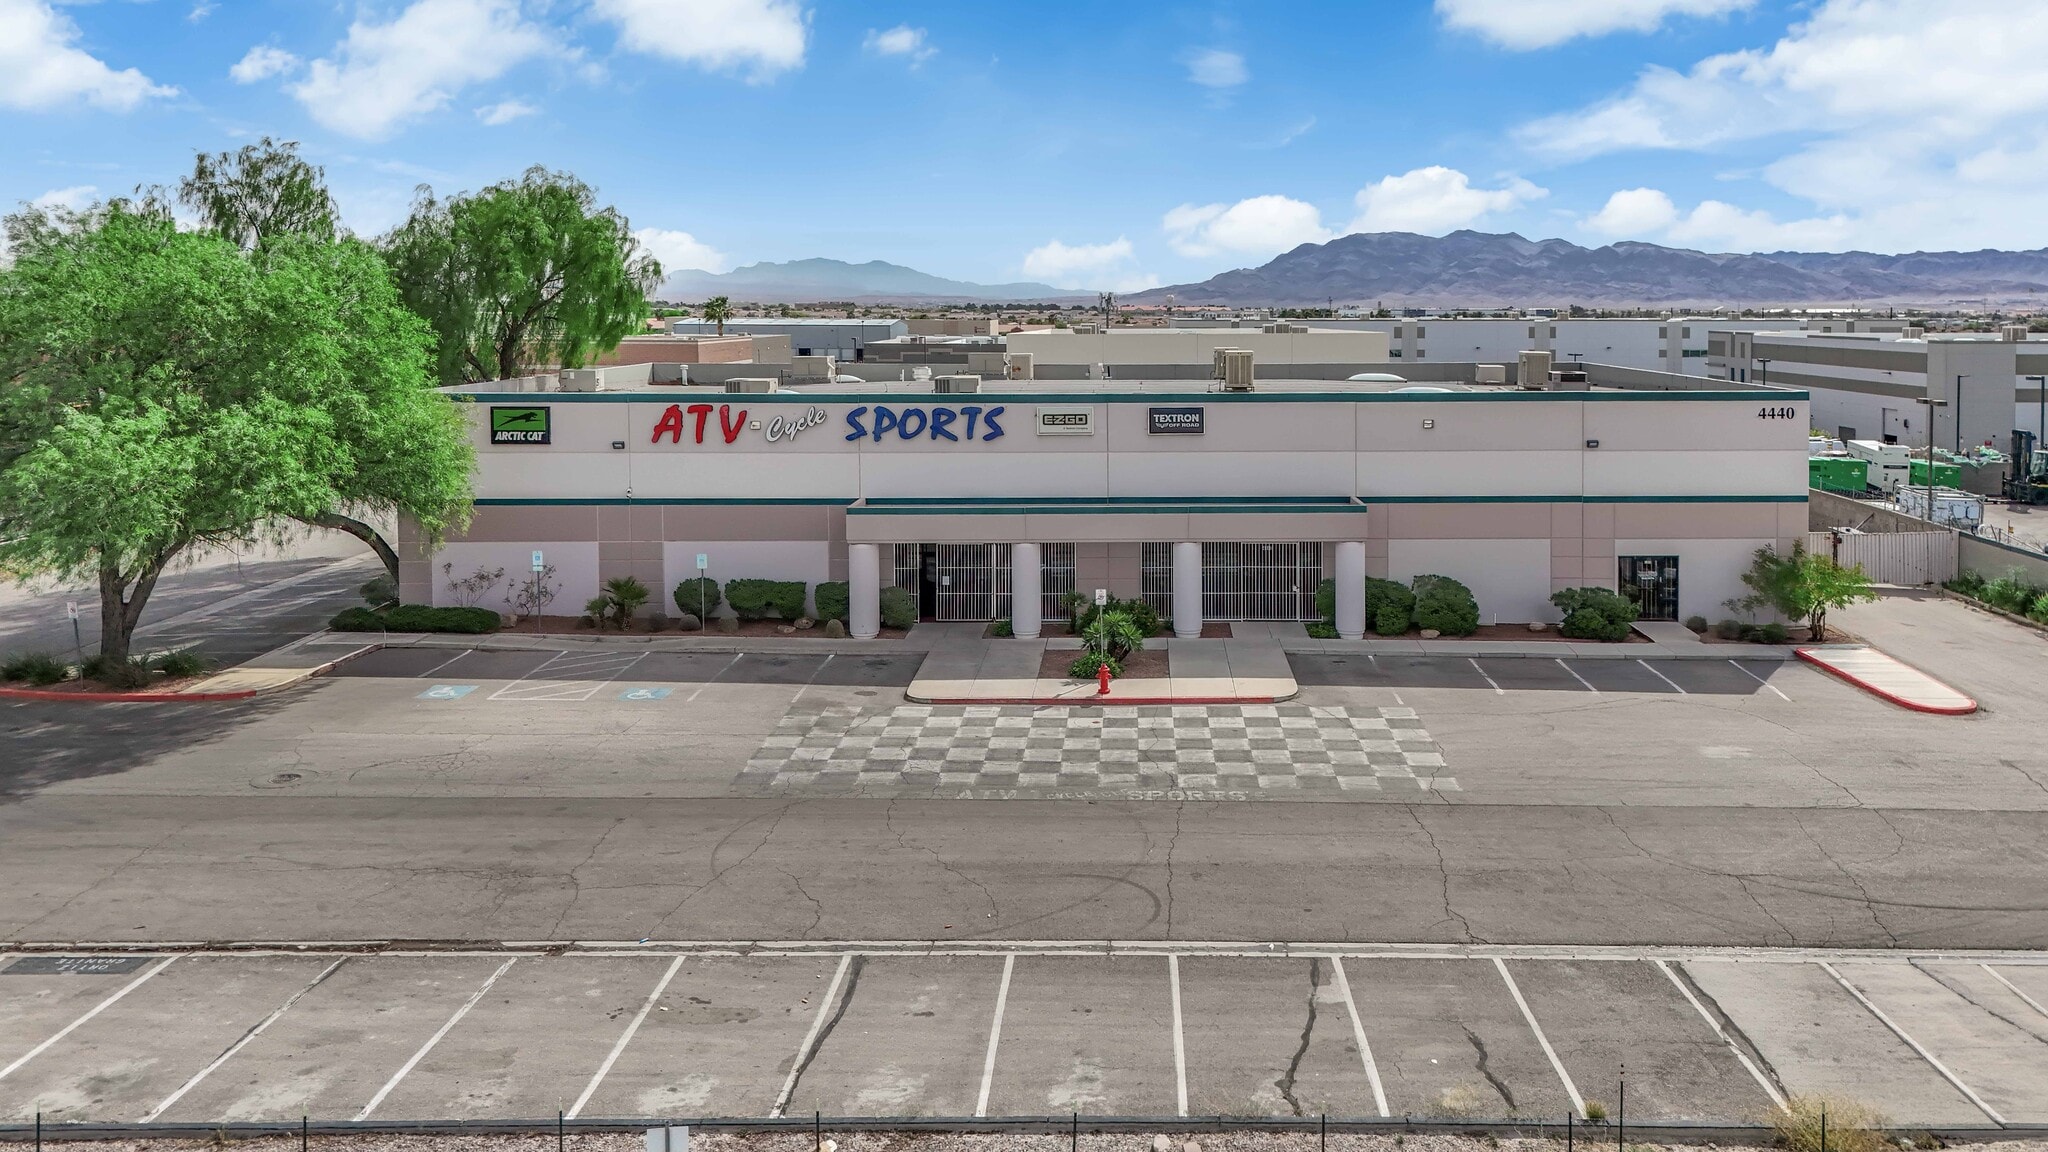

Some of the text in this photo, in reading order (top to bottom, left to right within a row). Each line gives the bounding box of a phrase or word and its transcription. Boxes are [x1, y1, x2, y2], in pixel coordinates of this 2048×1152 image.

[1153, 414, 1200, 423] TEXTRON
[1758, 407, 1795, 420] 4440
[651, 404, 1005, 444] ATV Cycle SPORTS
[495, 431, 544, 441] ARCTIC CAT
[1128, 790, 1247, 800] SPORTS
